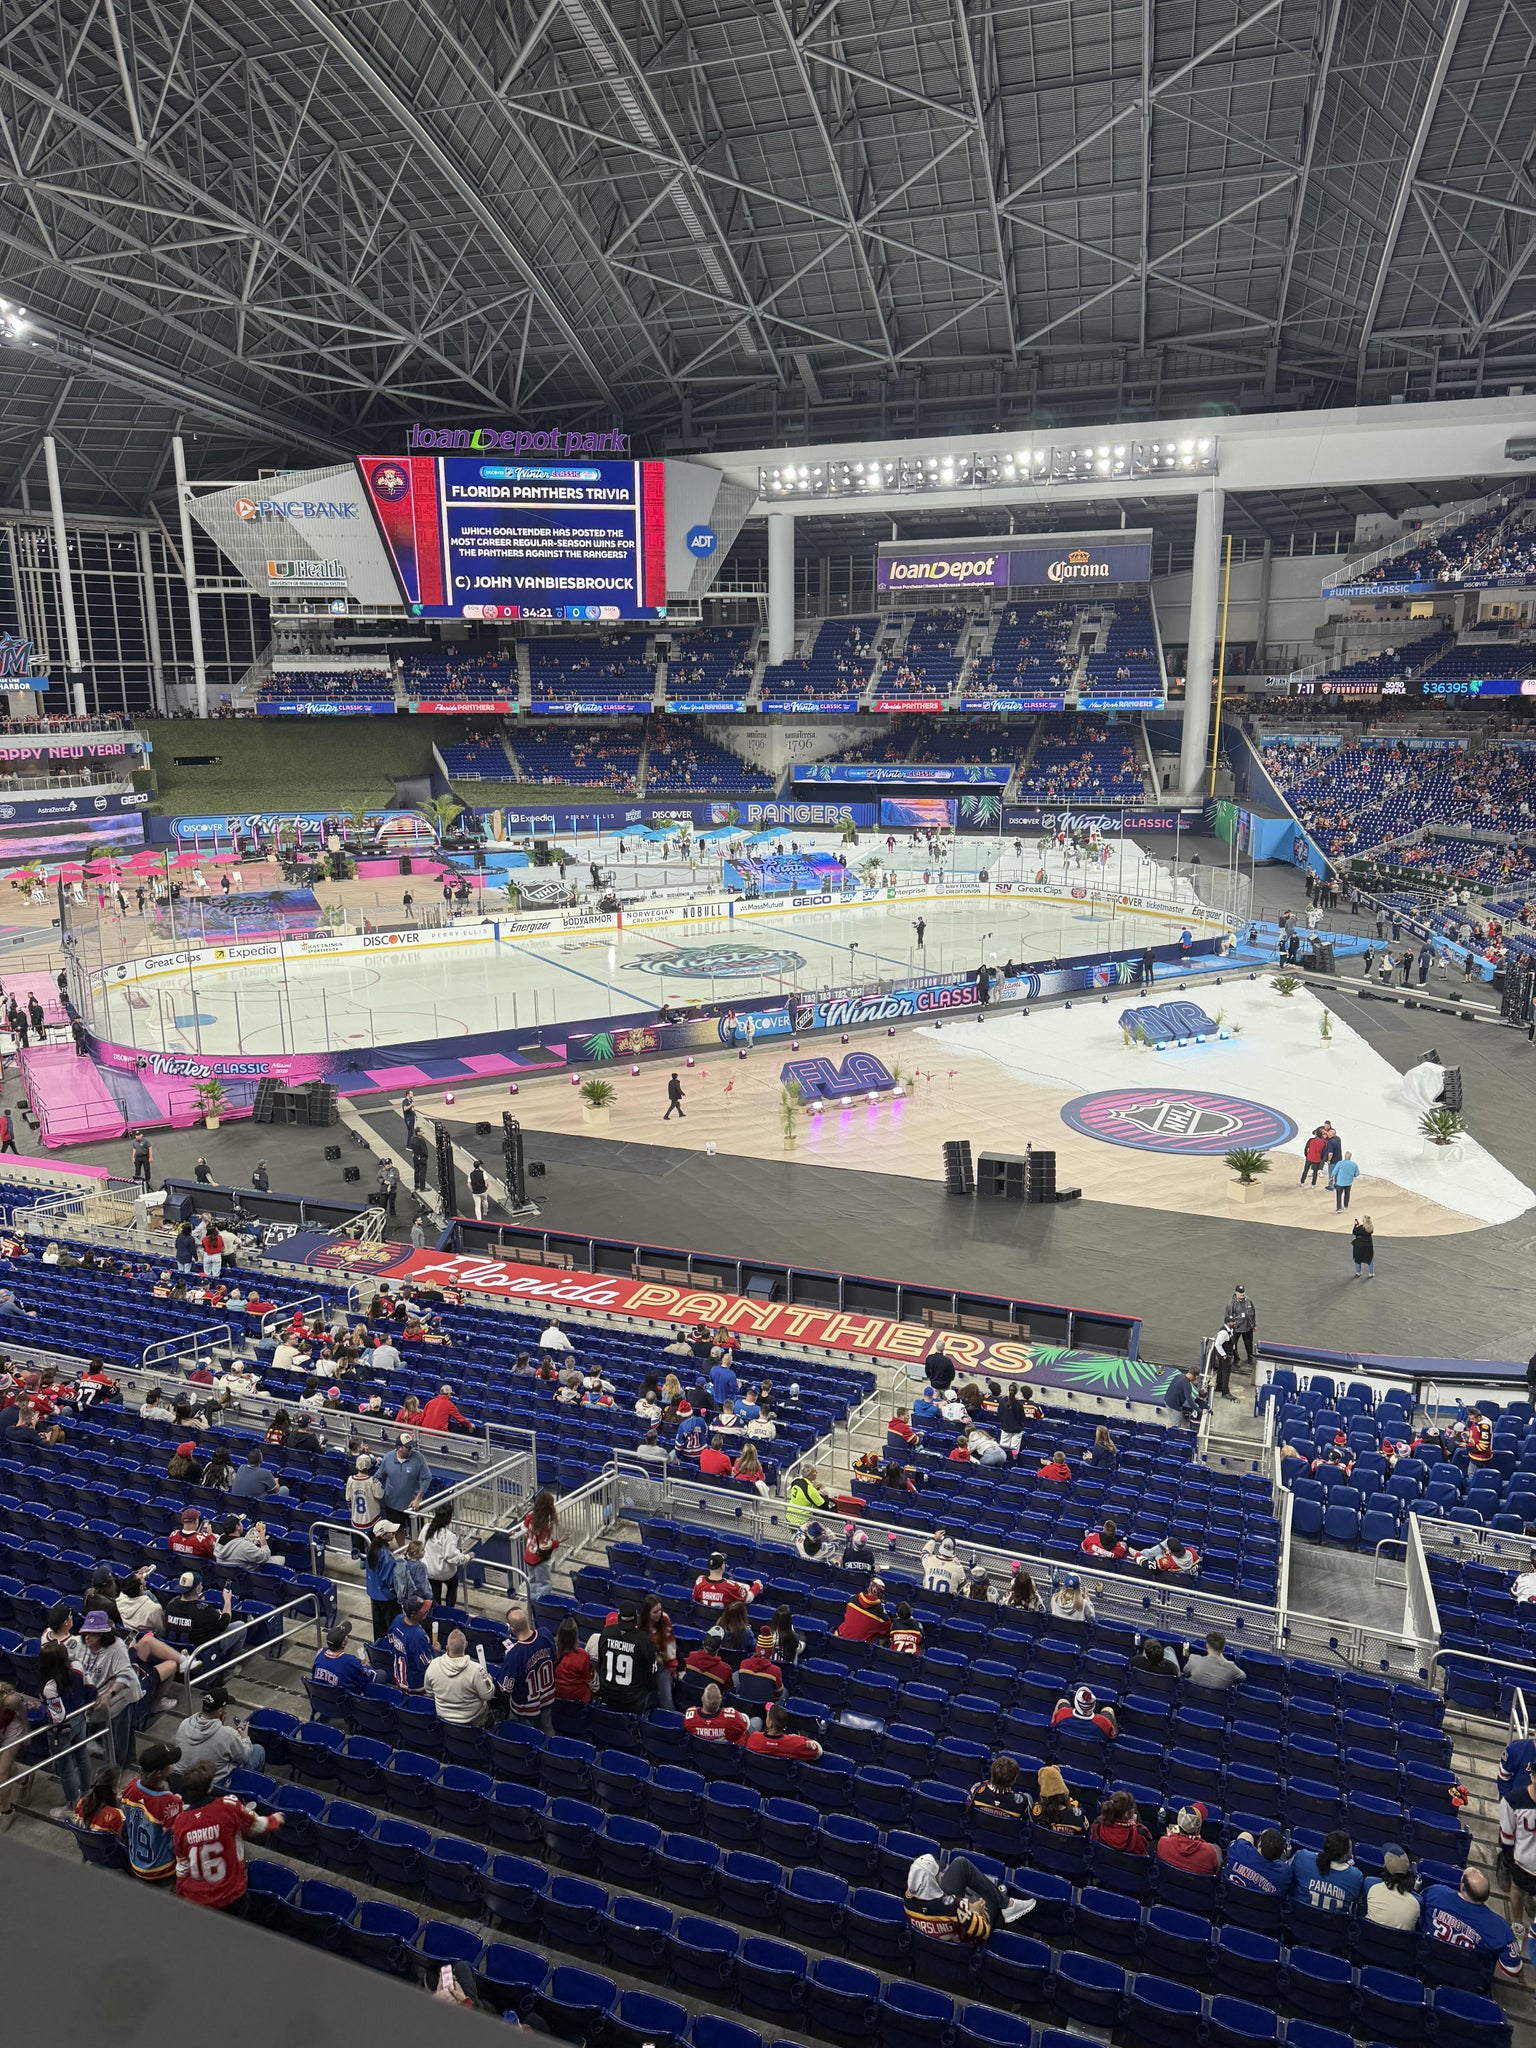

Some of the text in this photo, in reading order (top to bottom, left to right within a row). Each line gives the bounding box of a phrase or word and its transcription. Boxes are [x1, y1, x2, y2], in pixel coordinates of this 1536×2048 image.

[411, 423, 628, 457] loanDepot park
[514, 466, 550, 481] Winter
[551, 470, 580, 478] CLASSIC
[452, 485, 630, 500] FLORIDA PANTHERS TRIVIA
[302, 502, 358, 518] BANK
[461, 527, 492, 535] WHICH
[493, 528, 551, 536] GOALTENDER
[572, 529, 605, 537] POSTED
[450, 537, 476, 546] MOST
[477, 538, 511, 547] CAREER
[512, 539, 592, 547] REGULAR-SEASON
[593, 540, 616, 548] WINS
[690, 535, 714, 548] ADT
[458, 548, 628, 559] THE PANTHERS AGAINST THE RANGERS?
[889, 561, 995, 581] loanDepot
[1047, 560, 1110, 583] Corona
[455, 576, 634, 590] C) JOHN VANBIESBROUCK
[1329, 585, 1410, 597] #WINTERCLASSIC
[331, 602, 346, 612] 42
[503, 607, 512, 617] 0
[522, 608, 552, 618] 34:21
[572, 607, 580, 617] 0
[1297, 683, 1314, 694] 7:11
[1332, 686, 1378, 694] FOUNDATION
[1423, 682, 1468, 694] $36395
[305, 702, 338, 714] Winter
[573, 702, 602, 713] Winter
[791, 701, 819, 712] Winter
[991, 700, 1023, 711] Winter
[0, 744, 126, 760] APPY NEW YEAR!
[876, 768, 906, 779] Winter
[121, 794, 148, 805] GEICO
[520, 814, 552, 822] Expedia
[652, 810, 692, 819] DISCOVER
[748, 804, 853, 824] RANGERS
[1057, 812, 1122, 831] Winter
[1124, 818, 1173, 828] CLASSIC
[183, 824, 224, 833] DISCOVER
[537, 884, 558, 899] NHL
[1017, 885, 1040, 893] Great
[1043, 886, 1063, 895] Clips
[748, 901, 784, 910] MassMutual
[792, 895, 832, 907] GEICO
[627, 909, 675, 918] NORWEGIAN
[683, 905, 722, 918] NOBULL
[1146, 902, 1185, 914] ticketmaster
[463, 928, 488, 936] ELLIS
[510, 920, 551, 933] Energizer
[363, 933, 419, 947] DISCOVER
[229, 946, 277, 959] Expedia
[144, 953, 201, 970] Great Clips
[819, 987, 982, 1026] Winter CLASSI
[800, 1009, 812, 1025] NHL
[1134, 1003, 1213, 1043] NYR
[149, 1054, 211, 1077] Winter
[213, 1063, 269, 1074] CLASSIC
[800, 1052, 894, 1094] FLA
[1165, 1109, 1192, 1132] NHL
[410, 1255, 1034, 1374] Florida PANTHERS
[355, 1496, 366, 1514] 8
[930, 1568, 953, 1579] PANARIN
[703, 1591, 724, 1601] BARKOV
[607, 1639, 636, 1652] TKACHUK
[604, 1651, 634, 1686] 19
[525, 1659, 556, 1699] 10
[696, 1727, 726, 1737] TKACHUK
[186, 1824, 221, 1845] BARKOV
[189, 1841, 226, 1882] 16
[1308, 1879, 1346, 1900] PANARIN
